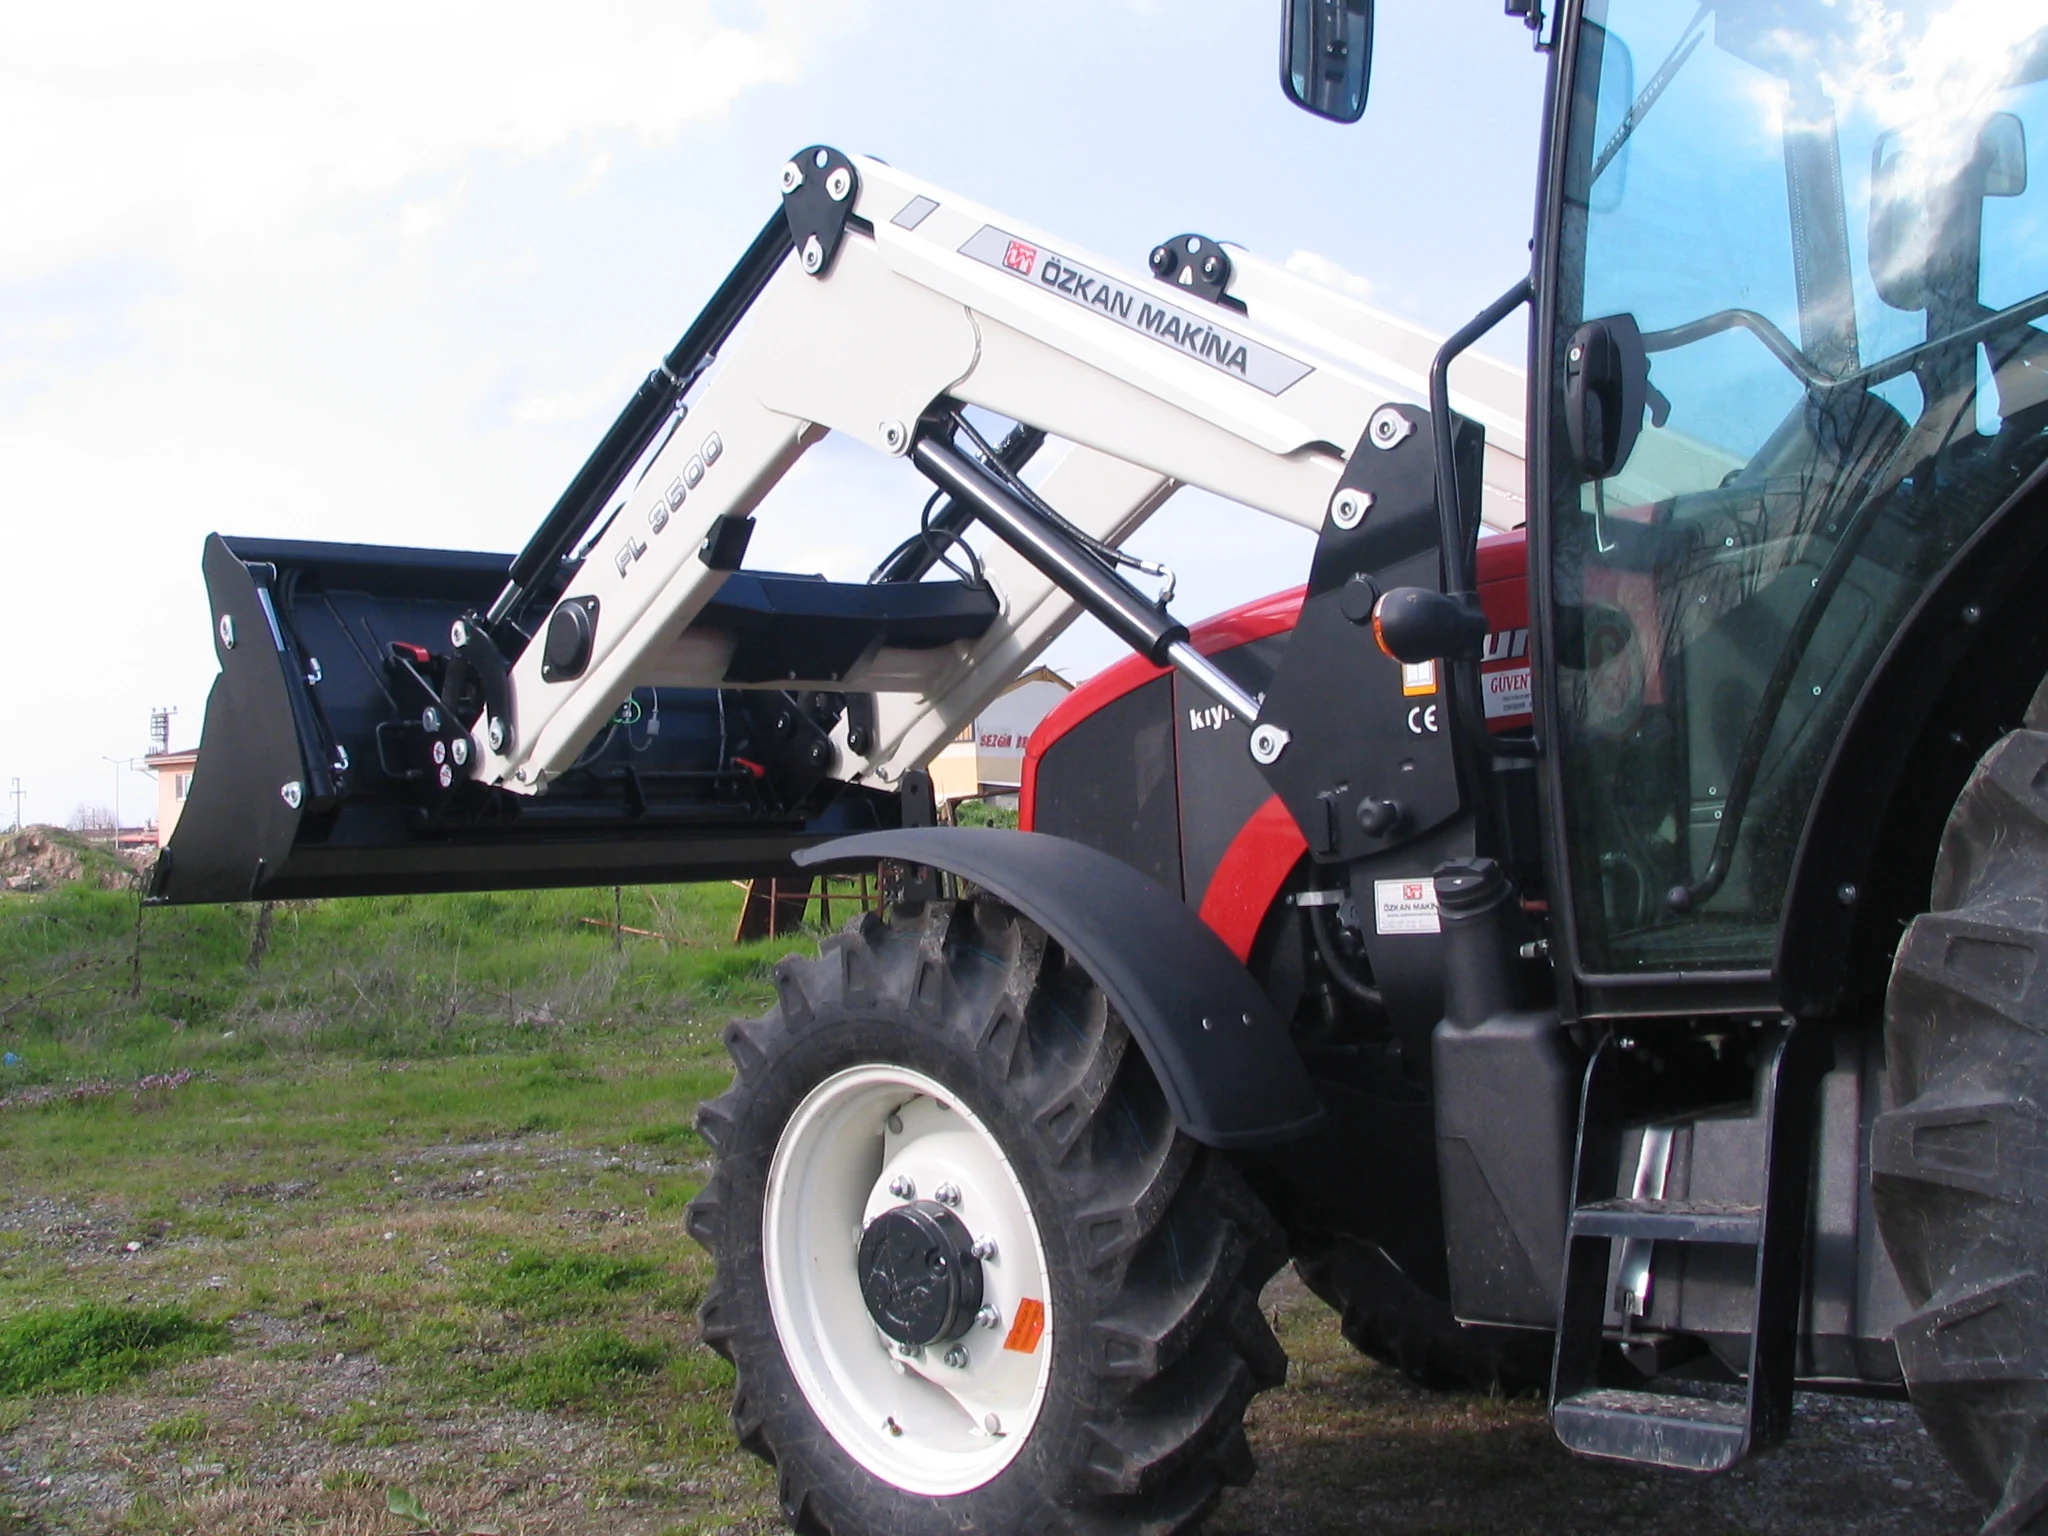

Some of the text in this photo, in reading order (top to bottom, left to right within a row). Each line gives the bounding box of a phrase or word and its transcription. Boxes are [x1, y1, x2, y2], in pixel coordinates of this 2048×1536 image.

[1040, 256, 1247, 376] ÖZKAN MAKİNA
[614, 431, 723, 579] FL 3500
[1407, 705, 1438, 734] CE
